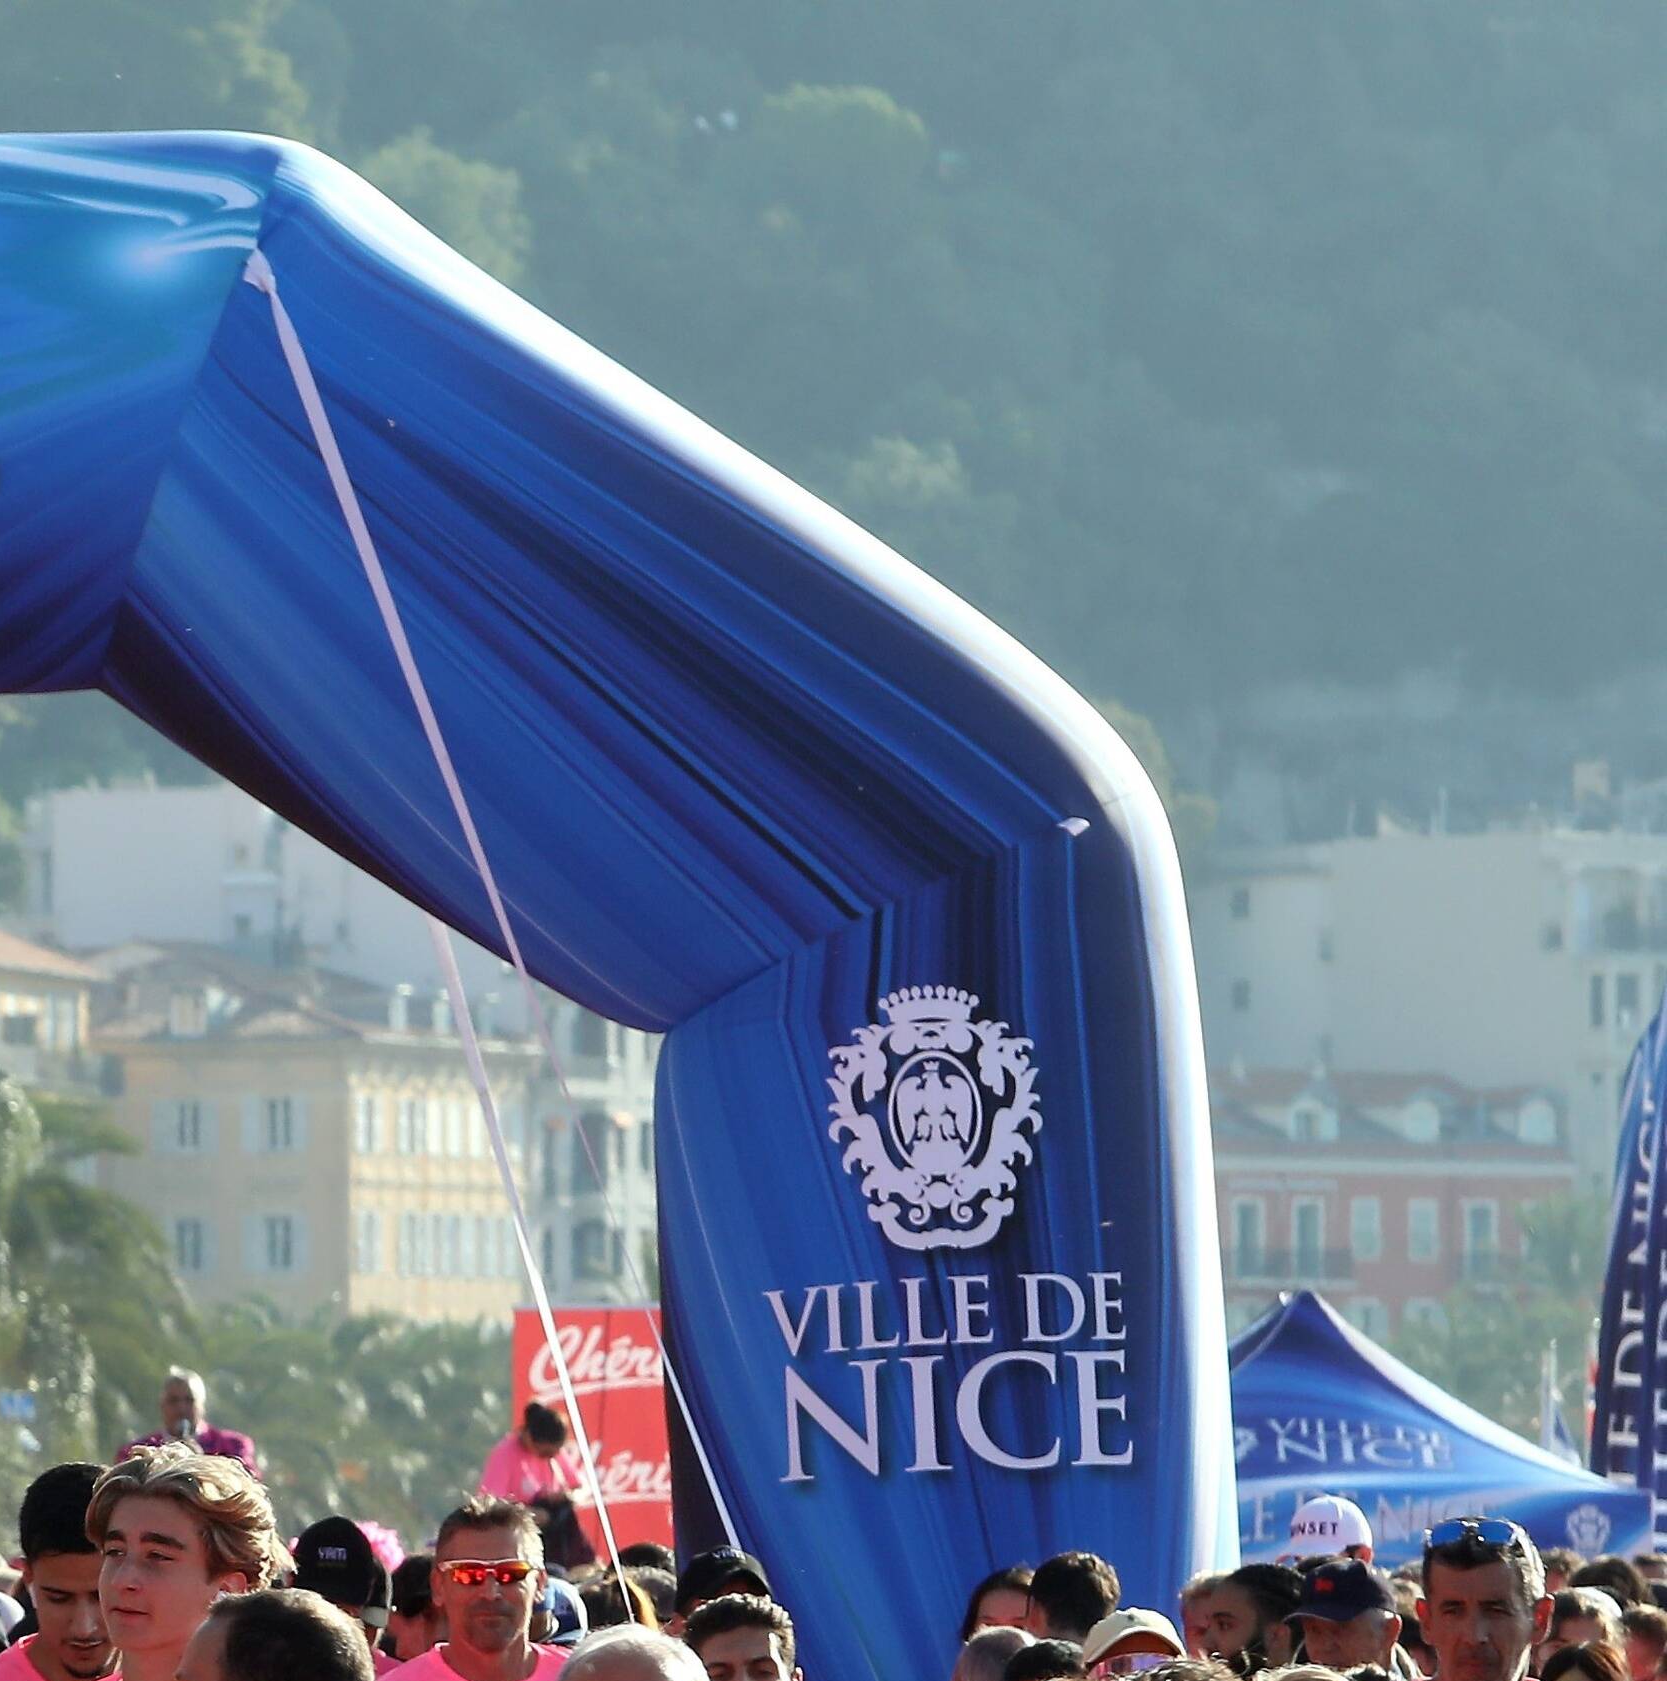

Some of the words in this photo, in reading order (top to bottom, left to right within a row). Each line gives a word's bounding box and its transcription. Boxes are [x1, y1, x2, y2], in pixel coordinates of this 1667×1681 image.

[762, 1274, 995, 1357] VILLE
[1017, 1271, 1128, 1343] DE
[779, 1349, 1134, 1483] NICE
